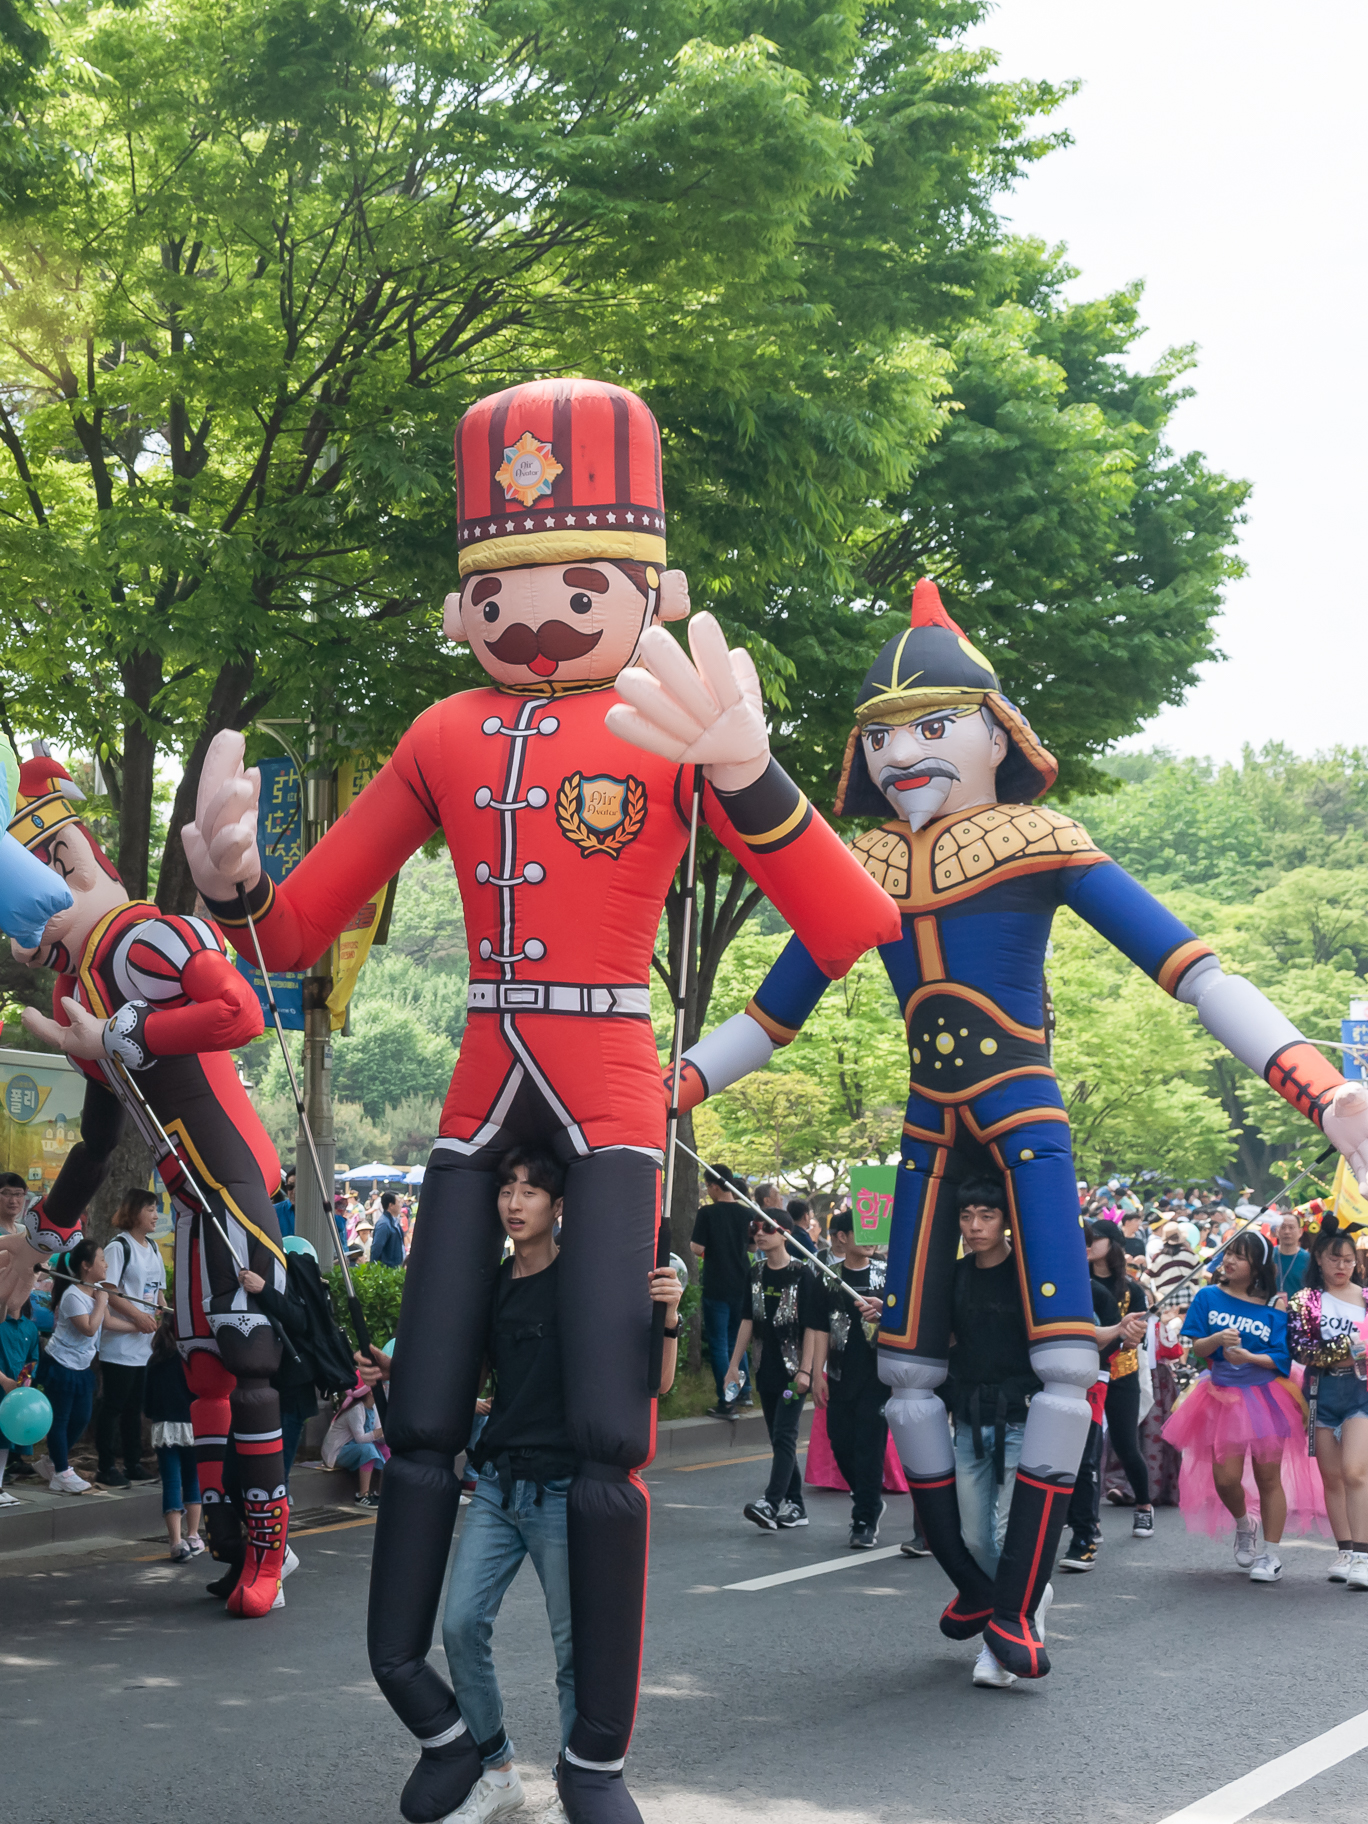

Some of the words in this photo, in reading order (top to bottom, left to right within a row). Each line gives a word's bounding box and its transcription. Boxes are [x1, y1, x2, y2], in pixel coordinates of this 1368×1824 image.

[520, 461, 533, 469] Air
[589, 790, 617, 805] Air
[587, 804, 619, 816] Avatar
[10, 1088, 35, 1113] 폴리
[1208, 1310, 1272, 1342] SOURCE
